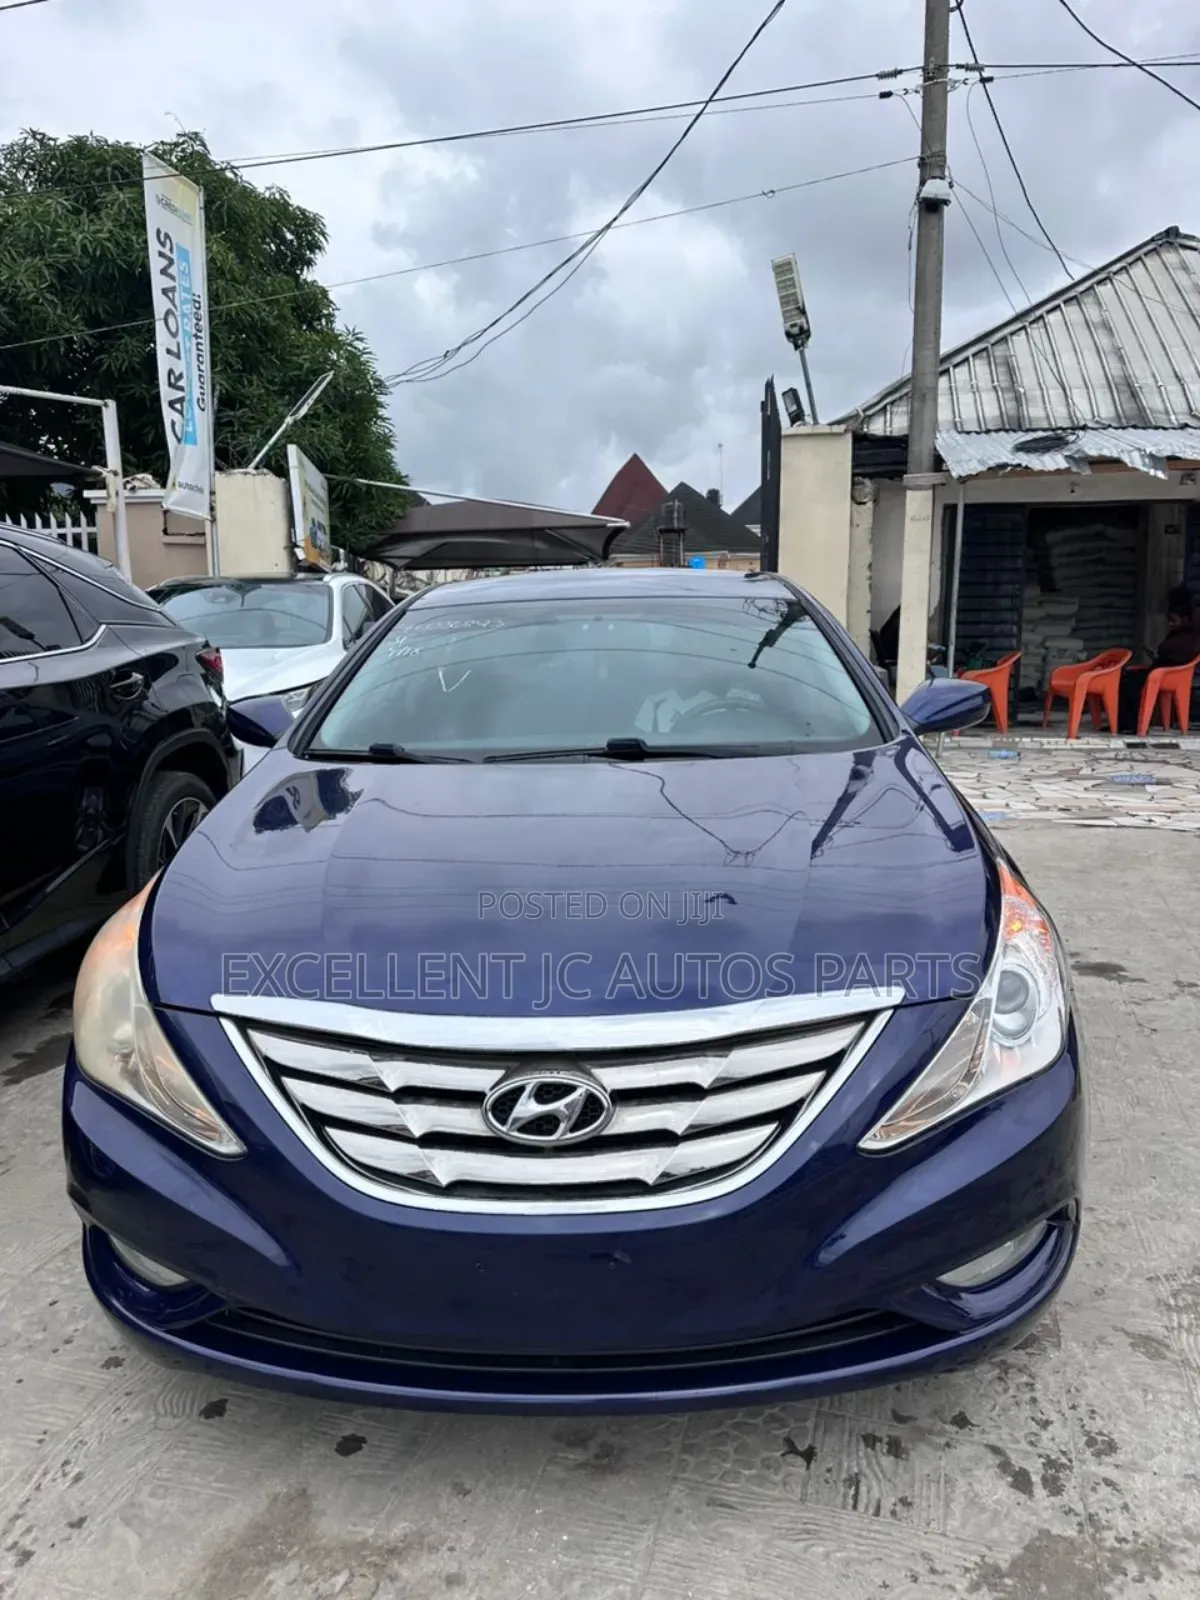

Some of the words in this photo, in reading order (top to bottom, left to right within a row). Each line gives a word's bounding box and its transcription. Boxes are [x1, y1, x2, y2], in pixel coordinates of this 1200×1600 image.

[156, 227, 182, 360] LOANS
[179, 260, 192, 330] RATES
[192, 292, 205, 412] Guaranteed!
[167, 367, 186, 445] CAR
